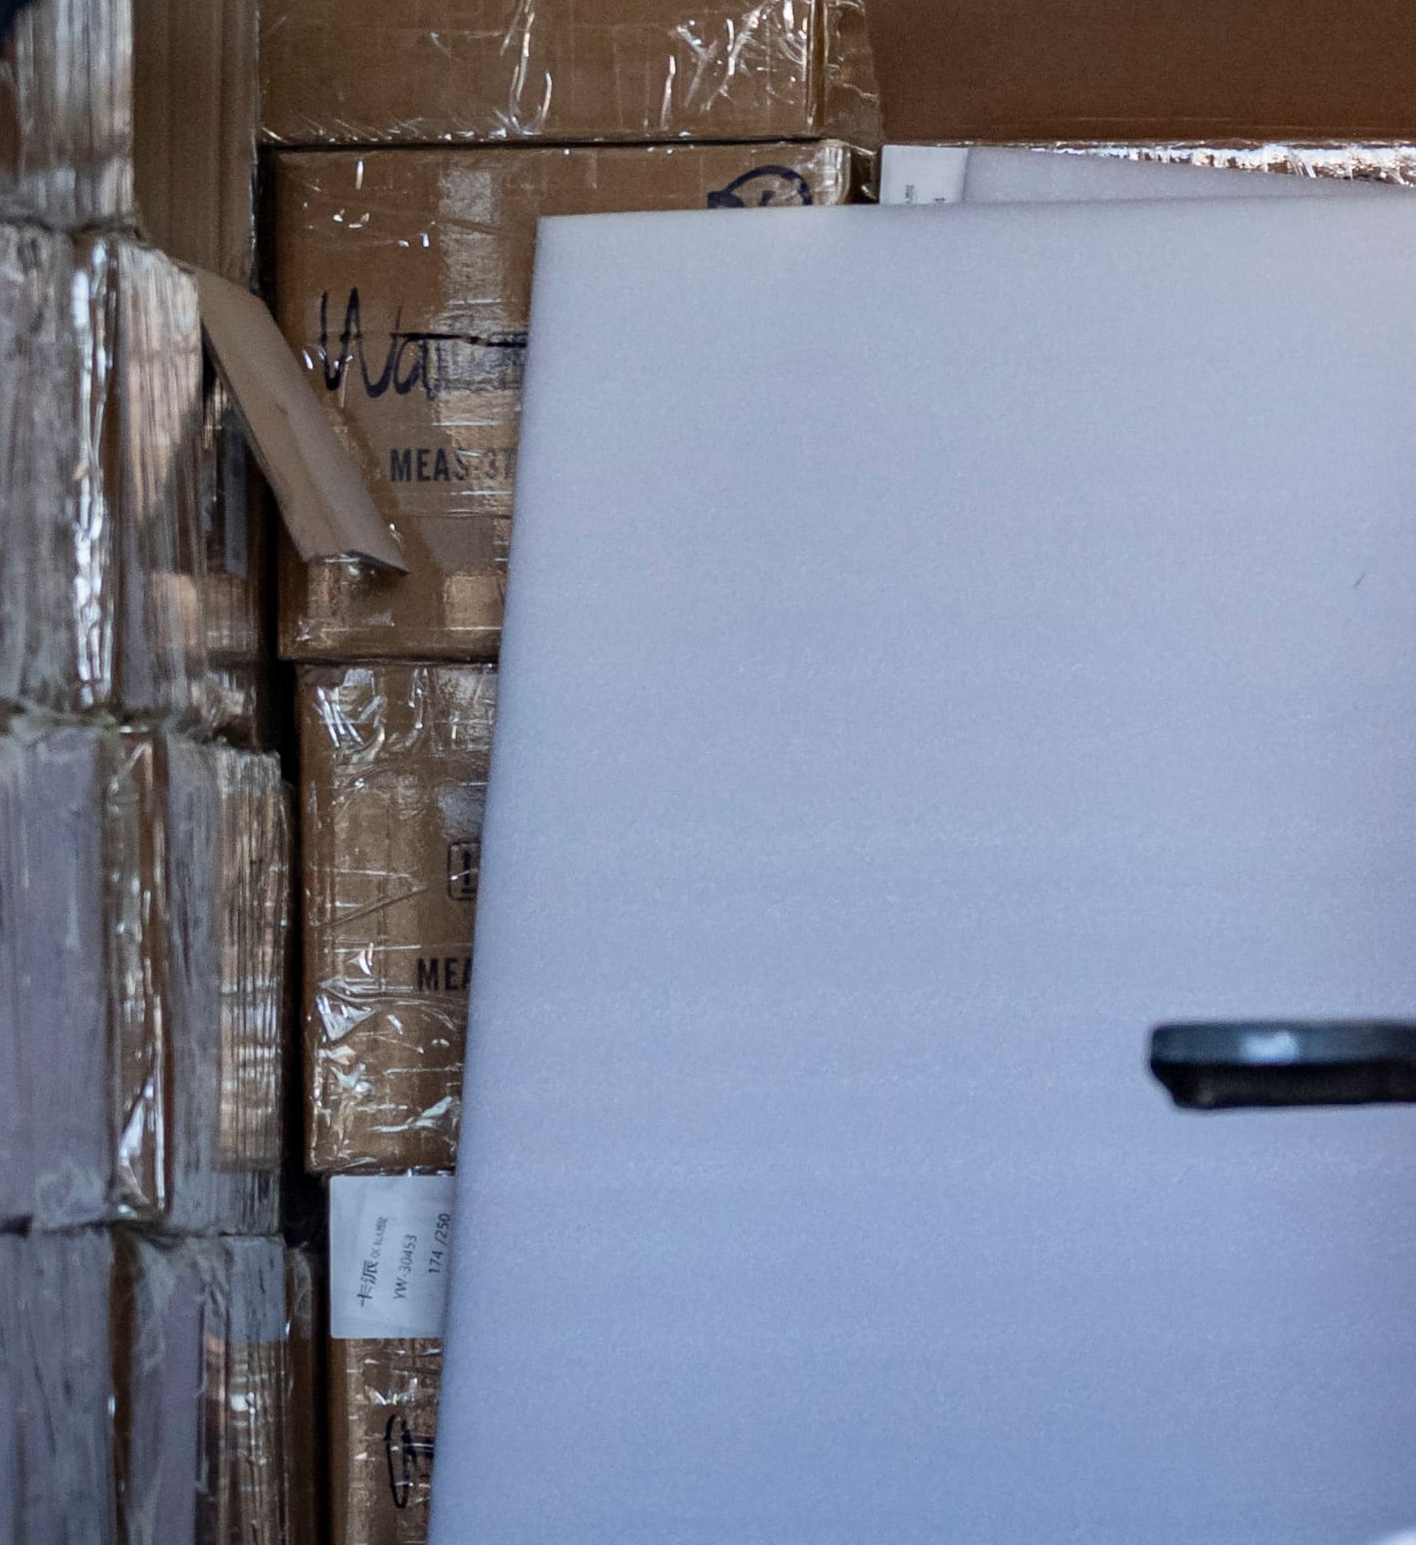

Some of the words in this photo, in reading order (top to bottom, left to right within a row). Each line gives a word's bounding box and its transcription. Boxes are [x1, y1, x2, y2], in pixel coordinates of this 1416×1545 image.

[434, 1212, 452, 1246] /250
[357, 1259, 379, 1307] 卡派
[393, 1234, 417, 1300] YW-30453
[428, 1250, 444, 1275] 174
